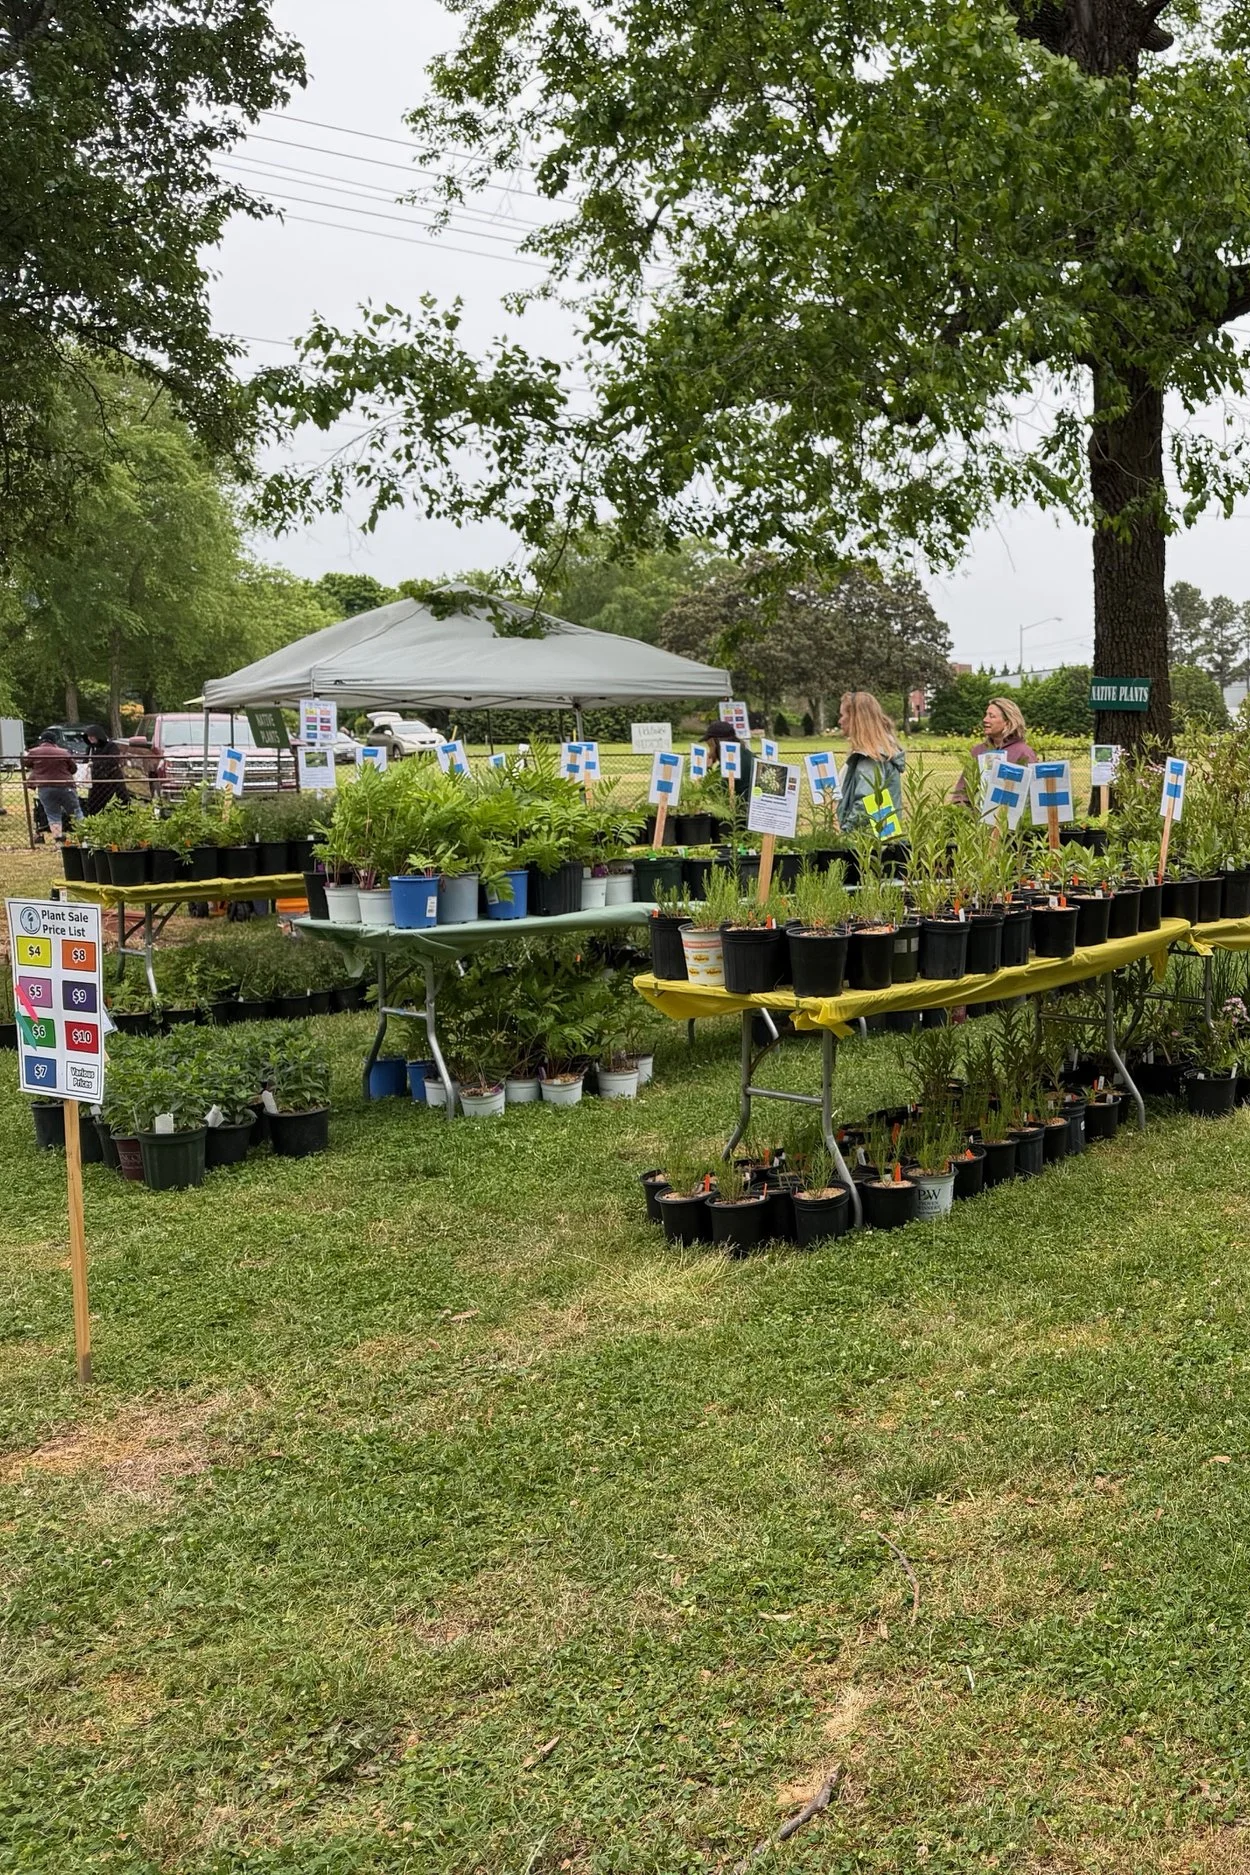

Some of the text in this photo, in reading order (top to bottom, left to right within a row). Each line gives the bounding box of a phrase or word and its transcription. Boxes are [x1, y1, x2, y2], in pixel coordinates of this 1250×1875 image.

[1090, 685, 1149, 702] NATIVE PLANTS
[41, 910, 89, 923] Plant Sale
[42, 924, 86, 937] Price List
[28, 944, 41, 957] $4
[73, 949, 86, 962] $8
[29, 985, 42, 998] $5
[73, 990, 86, 1003] $9
[33, 1025, 46, 1038] $6
[73, 1030, 92, 1044] $10
[35, 1065, 47, 1078] $7
[71, 1067, 95, 1079] Various
[73, 1077, 92, 1089] Prices
[918, 1188, 941, 1201] PW
